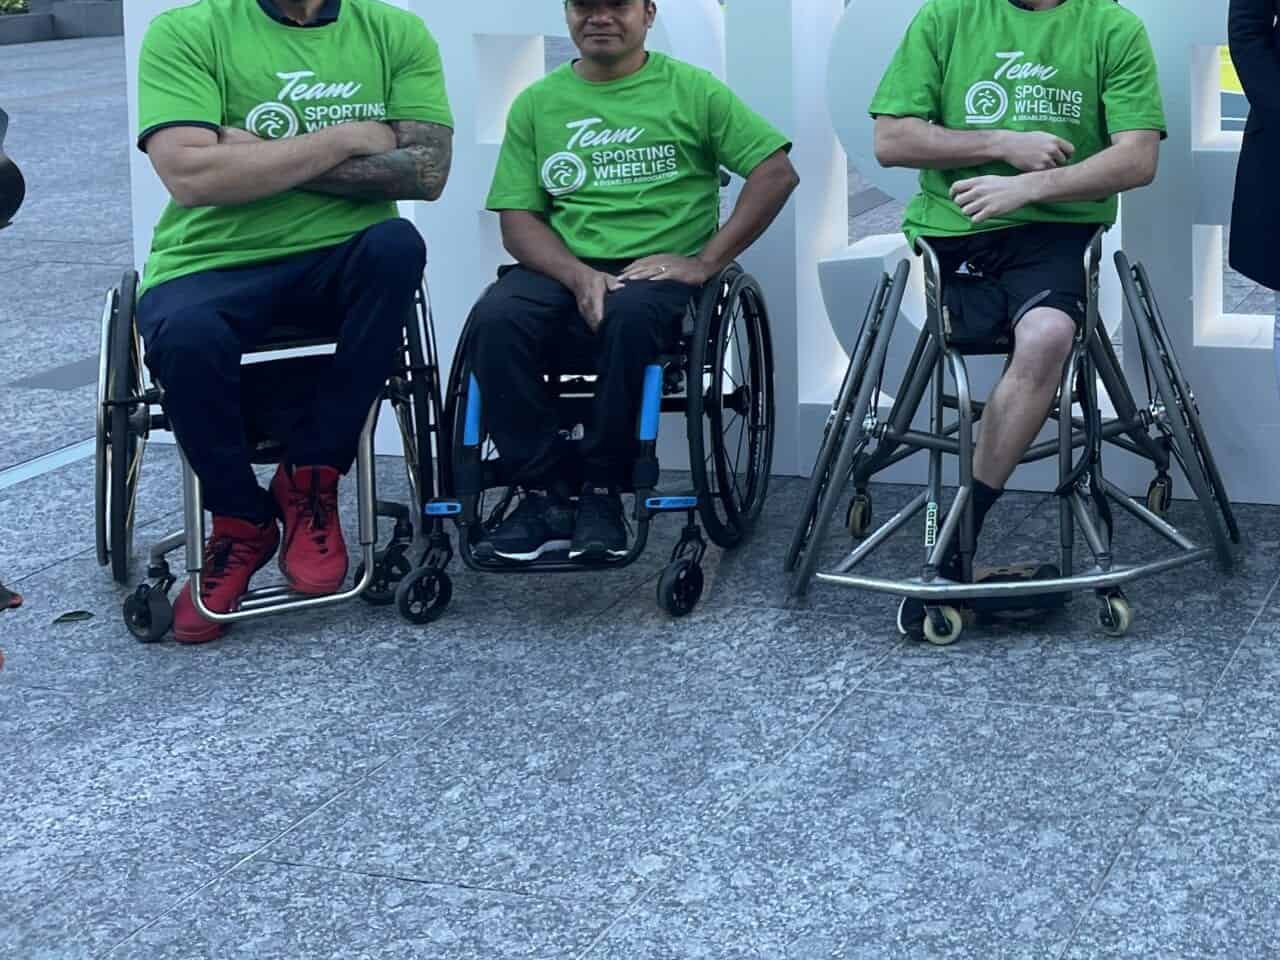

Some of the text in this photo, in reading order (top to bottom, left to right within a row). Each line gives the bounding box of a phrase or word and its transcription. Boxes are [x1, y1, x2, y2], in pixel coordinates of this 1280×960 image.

[994, 51, 1059, 81] Team
[275, 70, 362, 101] Team
[1015, 100, 1081, 118] WHELIES
[565, 117, 645, 150] Team
[592, 144, 676, 165] SPORTING
[593, 158, 677, 179] WHEELIES
